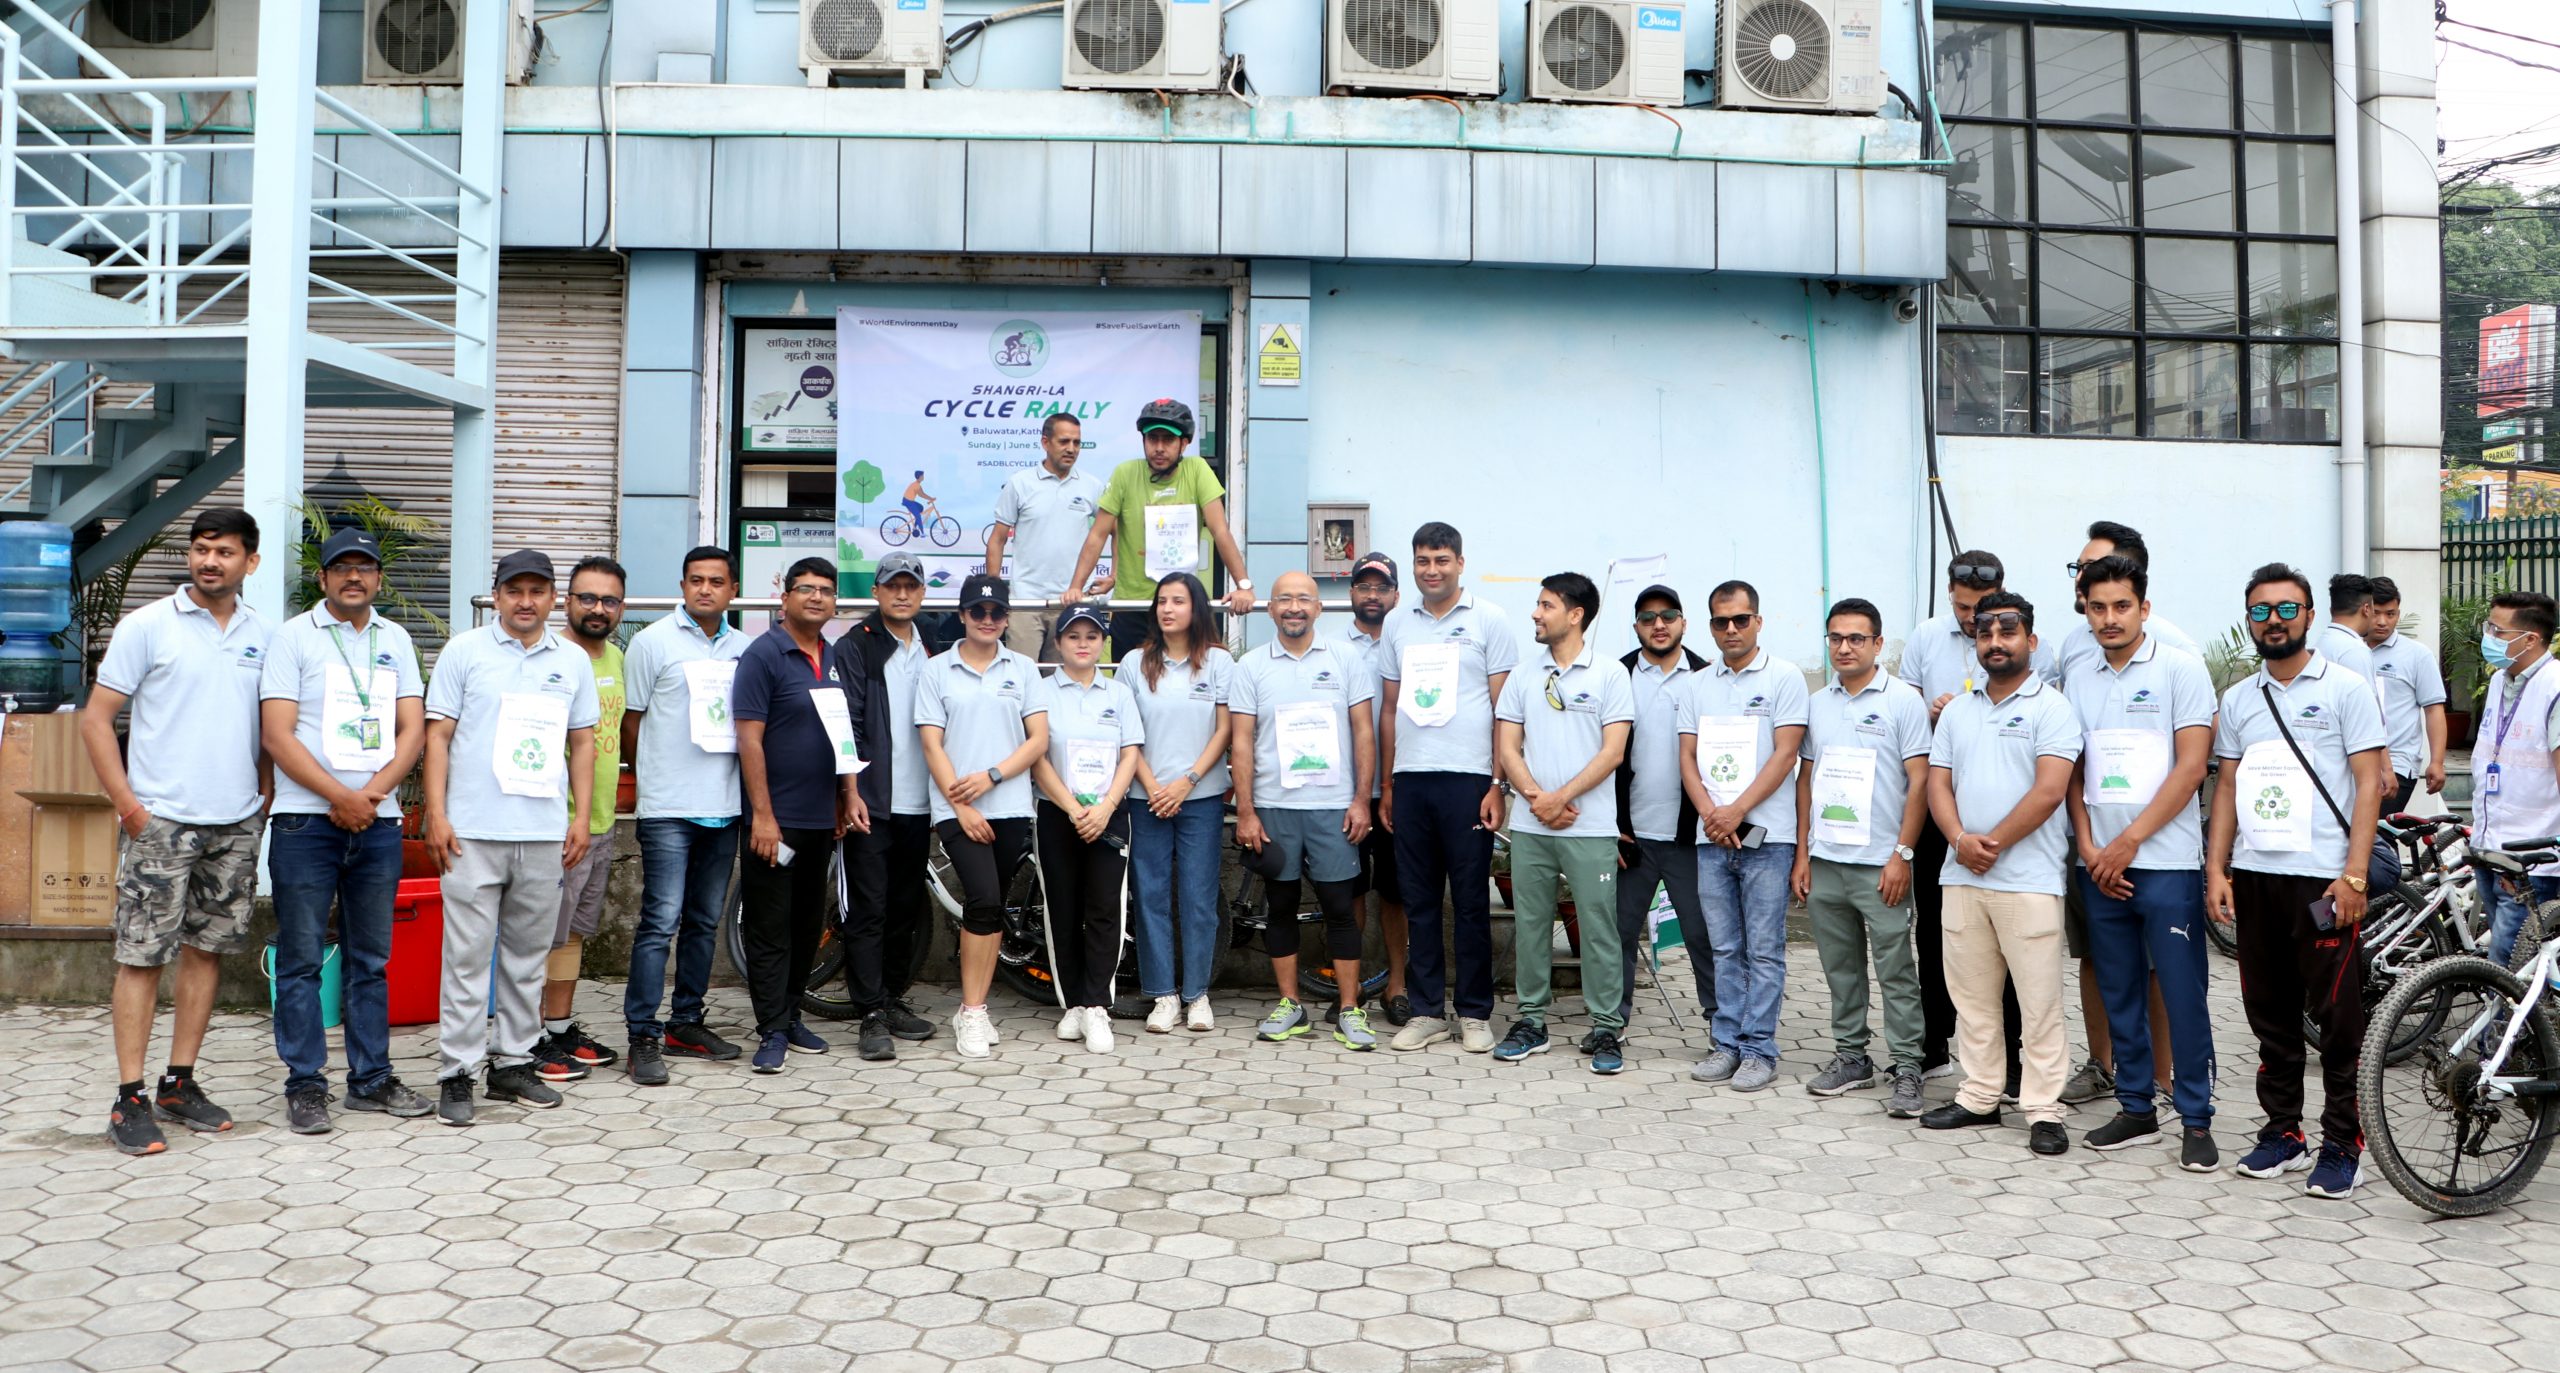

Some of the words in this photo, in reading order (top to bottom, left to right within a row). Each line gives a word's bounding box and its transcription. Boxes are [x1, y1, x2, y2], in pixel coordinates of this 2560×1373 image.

[859, 319, 959, 329] #WorldEnvironmentDay
[1095, 322, 1180, 330] #SaveFuelSaveEarth
[971, 384, 1066, 396] SHANGRI-LA
[924, 399, 1016, 418] CYCLE
[972, 427, 1042, 436] Baluwatar,Kath
[968, 441, 1001, 450] Sunday
[1008, 441, 1030, 449] June
[2488, 448, 2515, 460] PARKING
